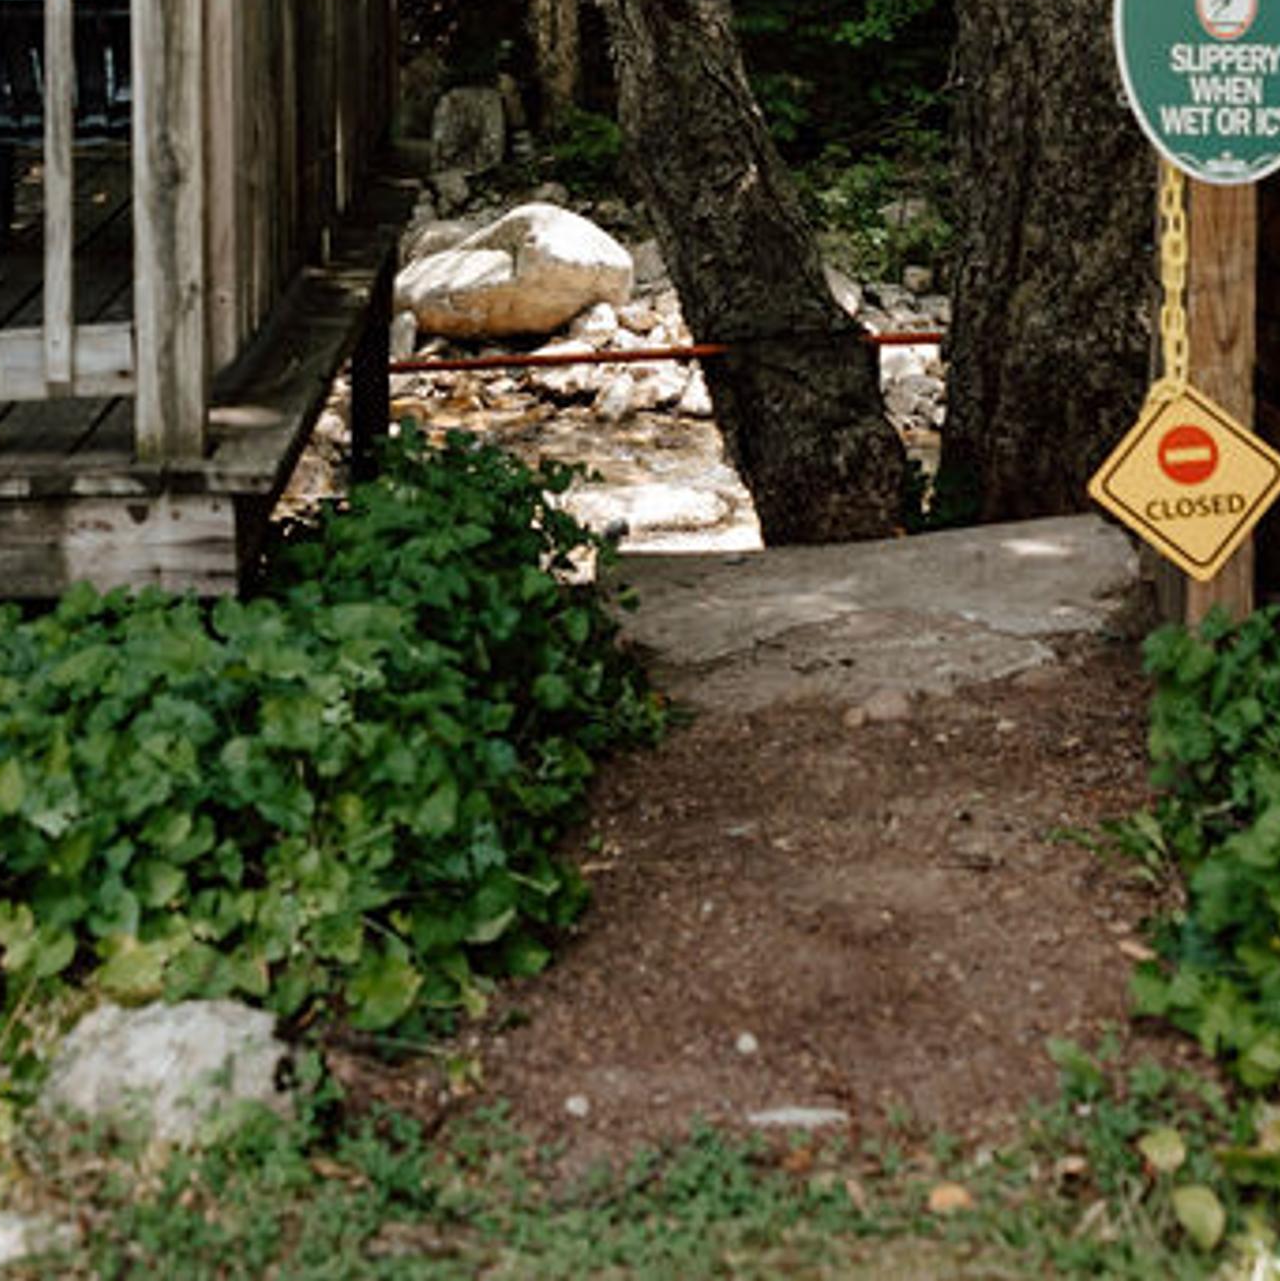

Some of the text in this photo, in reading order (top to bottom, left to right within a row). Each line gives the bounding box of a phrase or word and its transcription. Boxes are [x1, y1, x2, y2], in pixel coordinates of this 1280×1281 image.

[1190, 76, 1263, 104] WHEN
[1160, 107, 1211, 135] WET
[1214, 107, 1253, 135] OR
[1146, 493, 1246, 521] CLOSED
